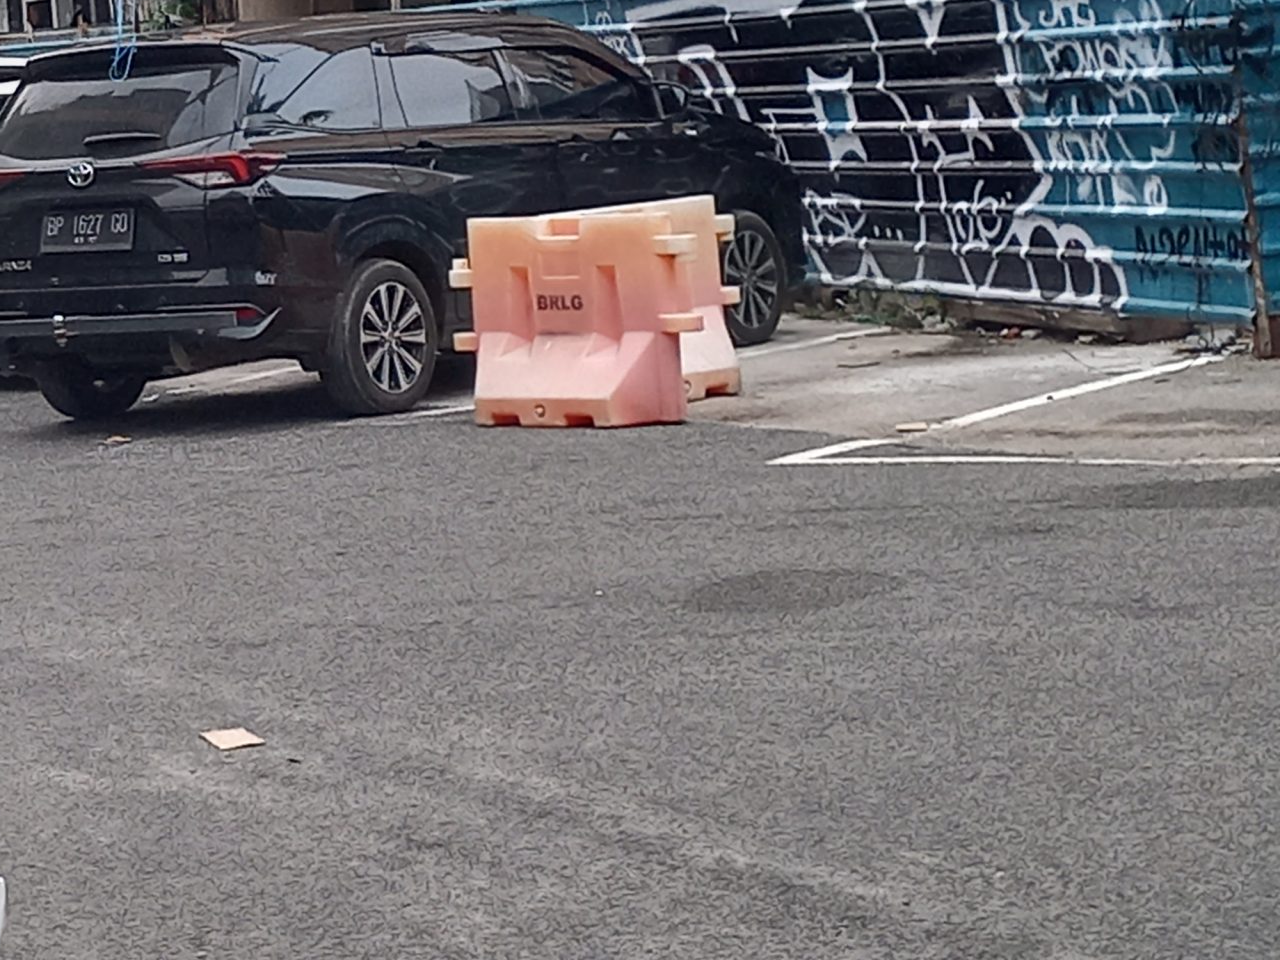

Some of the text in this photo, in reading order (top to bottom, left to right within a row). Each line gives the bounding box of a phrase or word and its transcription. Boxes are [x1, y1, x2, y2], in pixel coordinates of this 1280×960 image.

[46, 216, 65, 236] BP
[73, 214, 104, 235] 1627
[536, 293, 584, 311] BRLG
